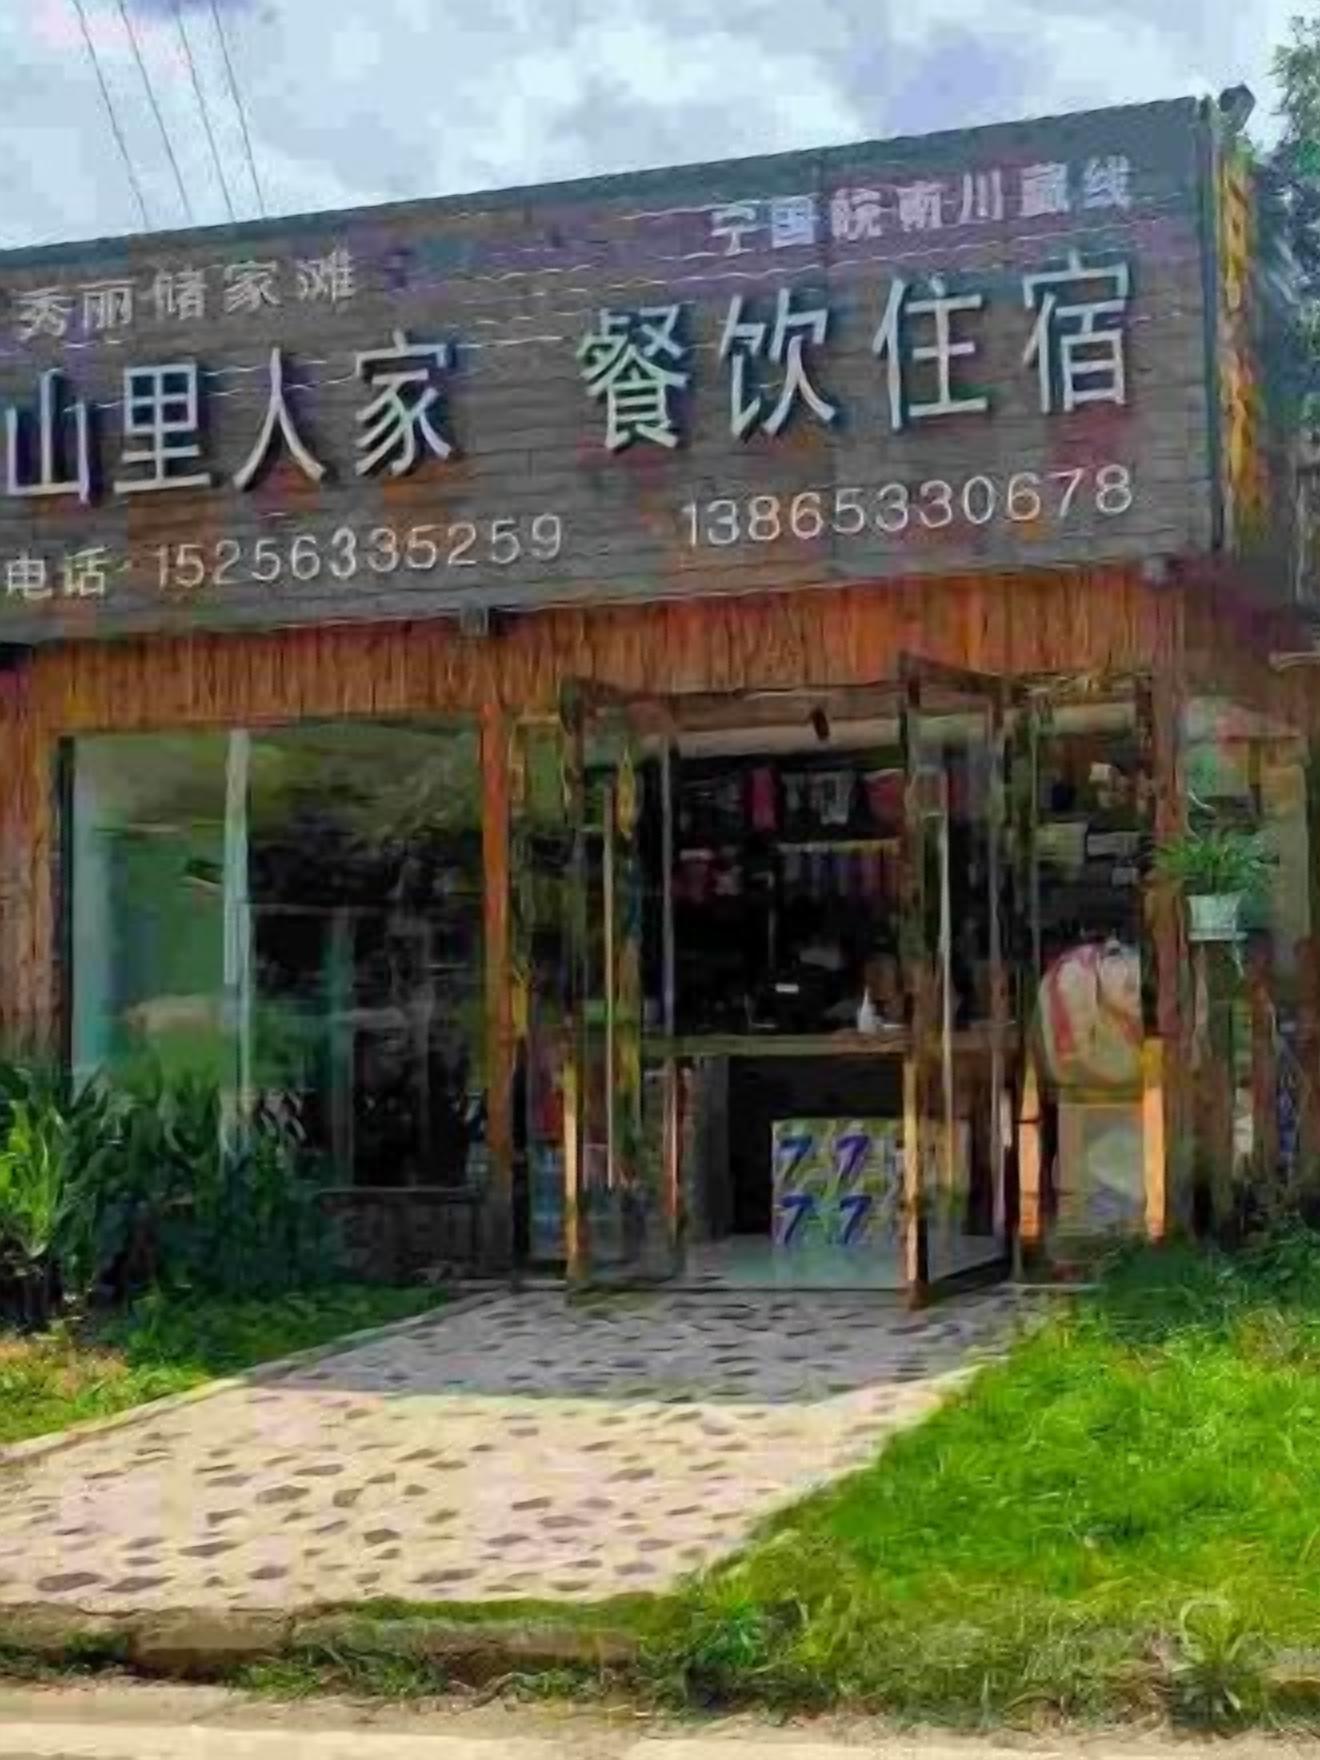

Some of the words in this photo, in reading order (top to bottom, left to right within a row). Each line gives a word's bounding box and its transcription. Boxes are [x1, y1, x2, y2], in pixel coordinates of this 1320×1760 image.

[2, 330, 456, 504] 山里人家
[574, 248, 1132, 453] 餐饮住宿
[682, 464, 1136, 547] 13865330678
[154, 513, 564, 590] 15256335259
